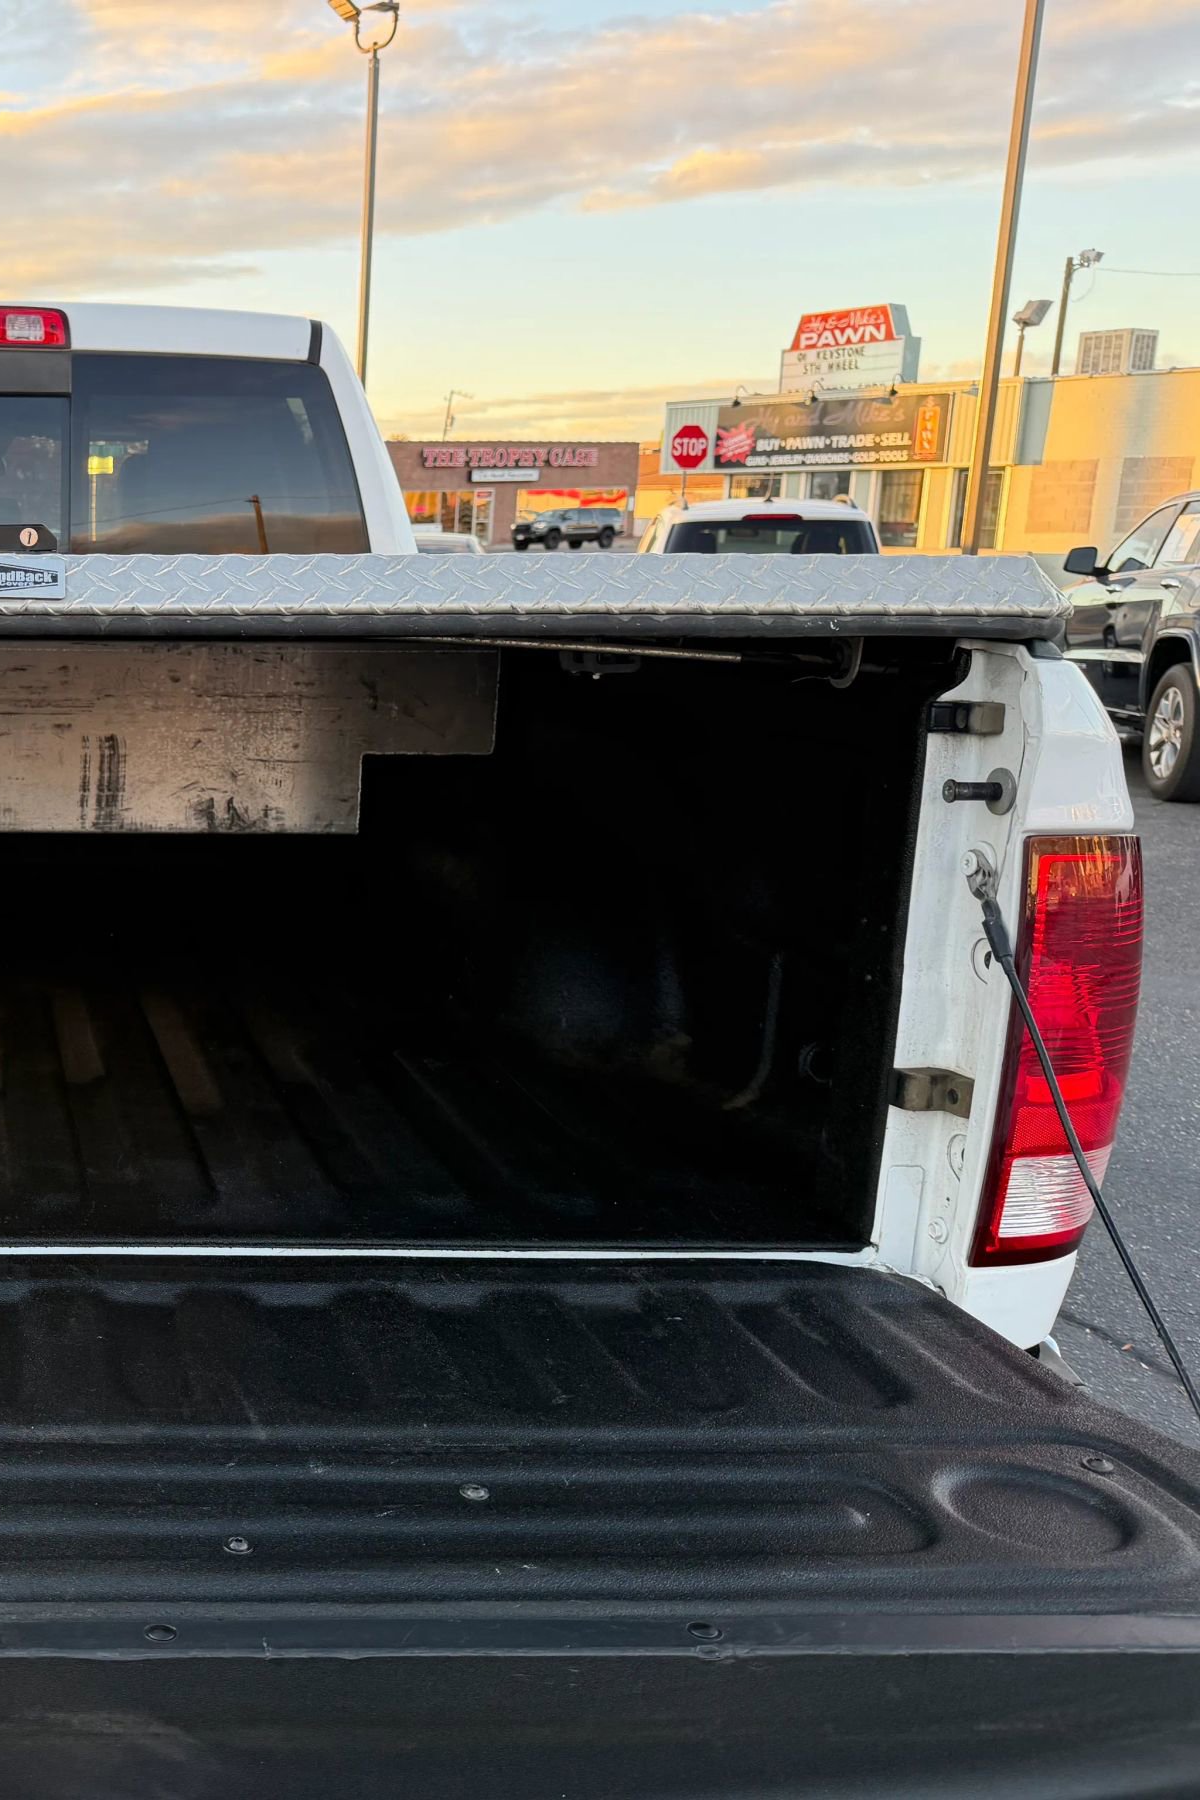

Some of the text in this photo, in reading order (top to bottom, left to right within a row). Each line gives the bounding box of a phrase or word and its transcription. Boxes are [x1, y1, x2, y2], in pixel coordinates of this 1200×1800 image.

[800, 323, 887, 349] PAWN
[816, 346, 866, 361] KEYSTONE
[672, 437, 707, 457] STOP
[756, 437, 781, 452] BUY
[785, 434, 824, 450] PAWN
[831, 431, 876, 448] TRADE
[879, 431, 912, 446] SELL
[423, 447, 599, 468] THE TROPHY CASE
